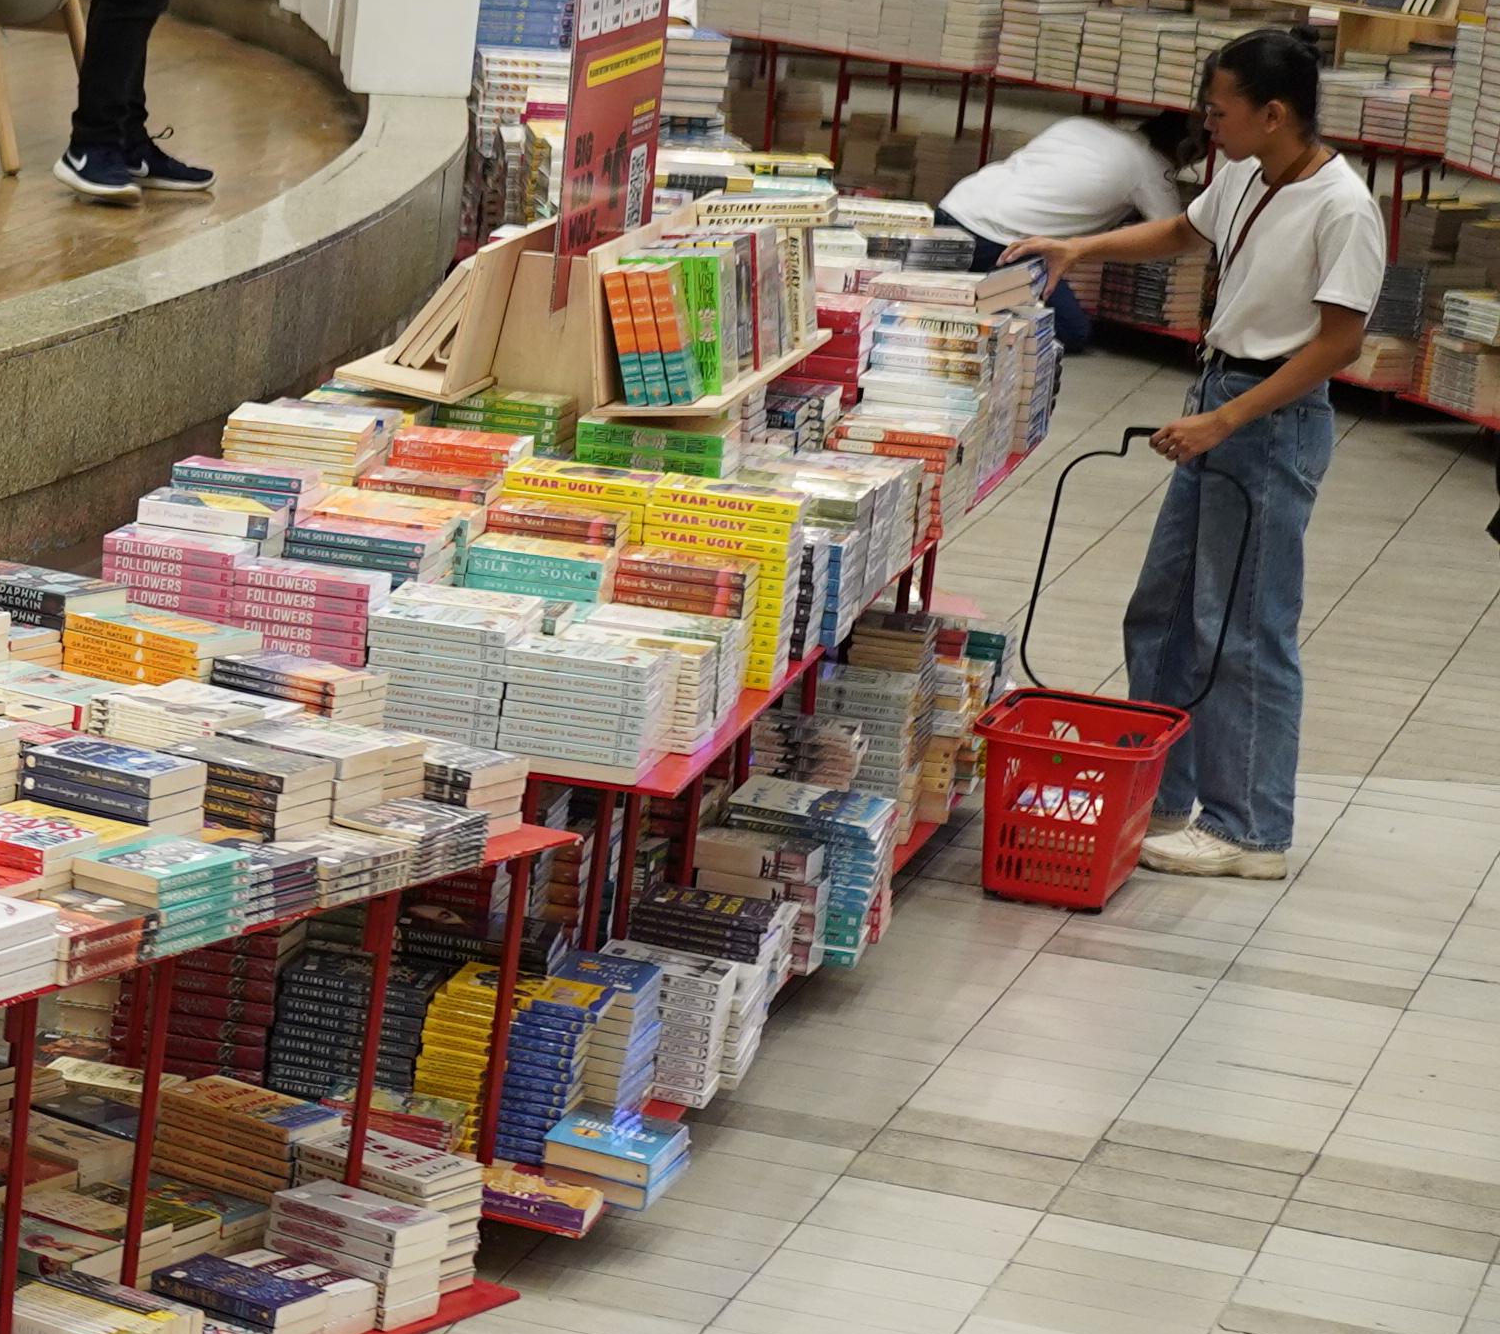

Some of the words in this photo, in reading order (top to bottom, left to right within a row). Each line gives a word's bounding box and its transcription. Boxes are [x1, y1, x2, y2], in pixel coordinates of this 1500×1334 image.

[574, 131, 594, 169] BIG
[706, 203, 762, 215] BESTIARY
[175, 468, 188, 477] THE
[190, 469, 213, 480] SISTER
[214, 472, 245, 483] SURPRISE
[522, 476, 559, 491] YEAR
[568, 481, 604, 496] UGLY
[116, 540, 183, 561] FOLLOWERS
[473, 558, 511, 573] SILK
[540, 567, 583, 582] SONG
[616, 575, 652, 590] Danielle
[654, 580, 671, 591] Steel
[0, 584, 44, 602] DAPHNE
[0, 593, 42, 610] MERKIN
[383, 1149, 447, 1172] HUMAN
